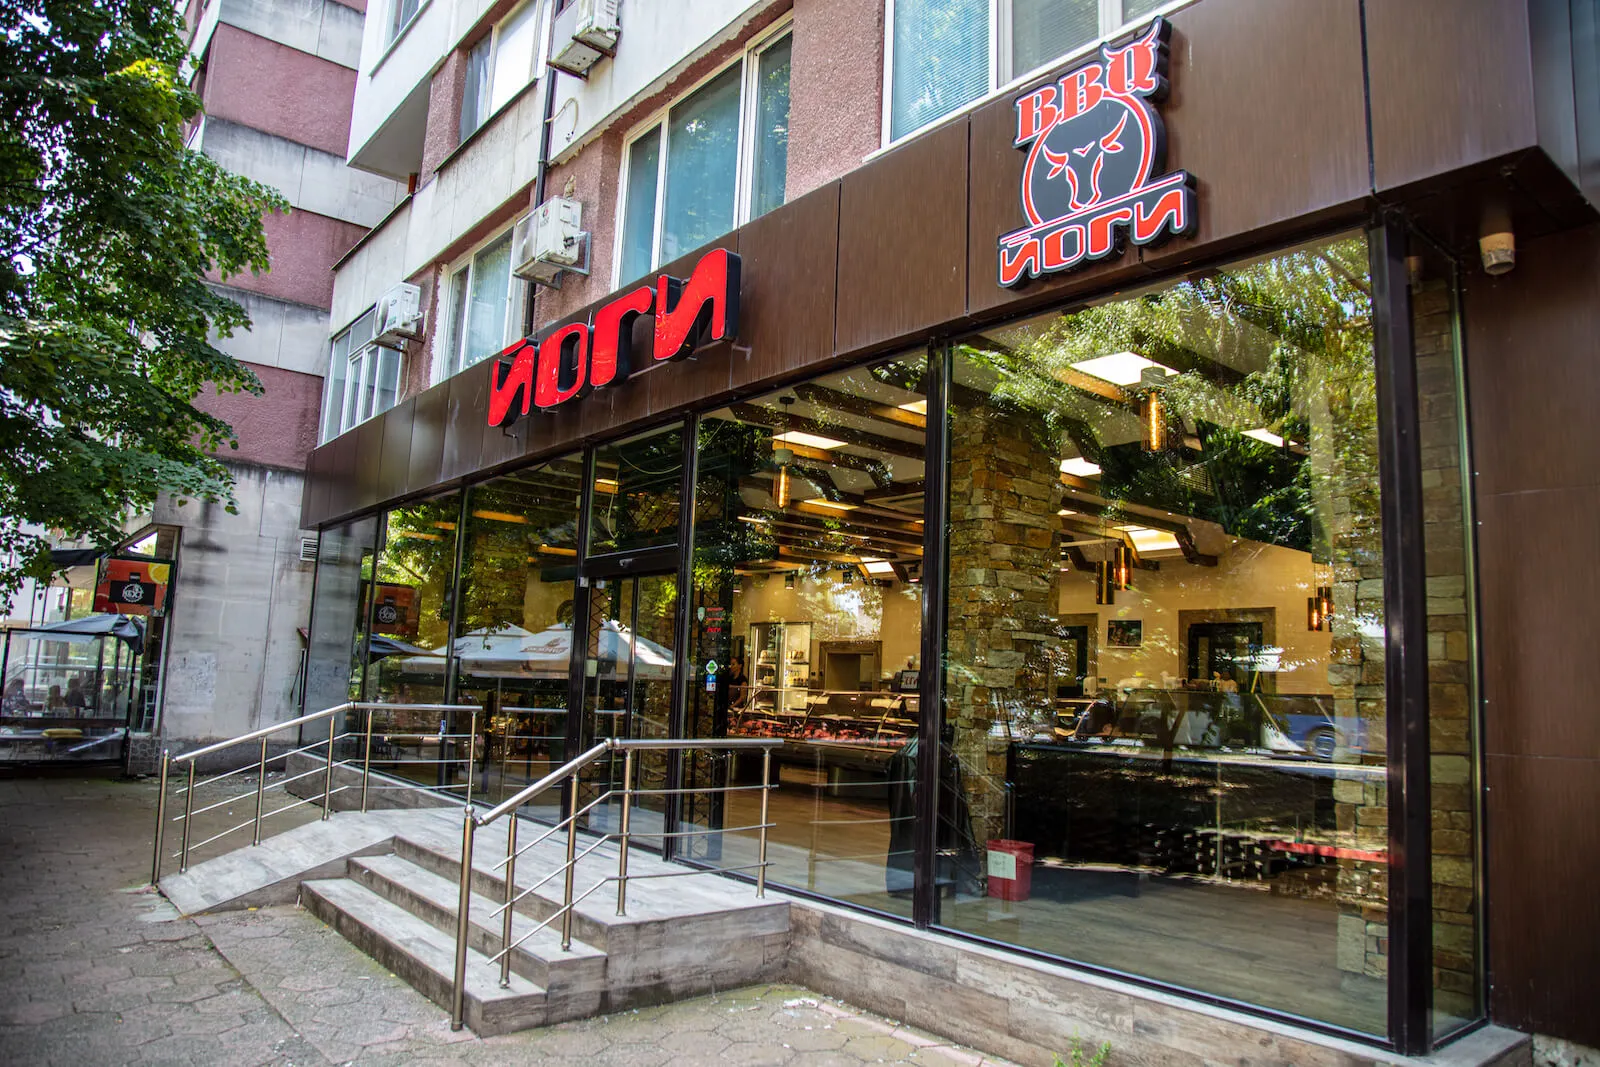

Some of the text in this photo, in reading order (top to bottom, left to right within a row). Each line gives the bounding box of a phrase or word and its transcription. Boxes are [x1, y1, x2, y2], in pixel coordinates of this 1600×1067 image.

[1015, 22, 1159, 144] BBQ
[1001, 190, 1183, 282] ЙОГИ
[488, 248, 727, 427] ЙОГИ
